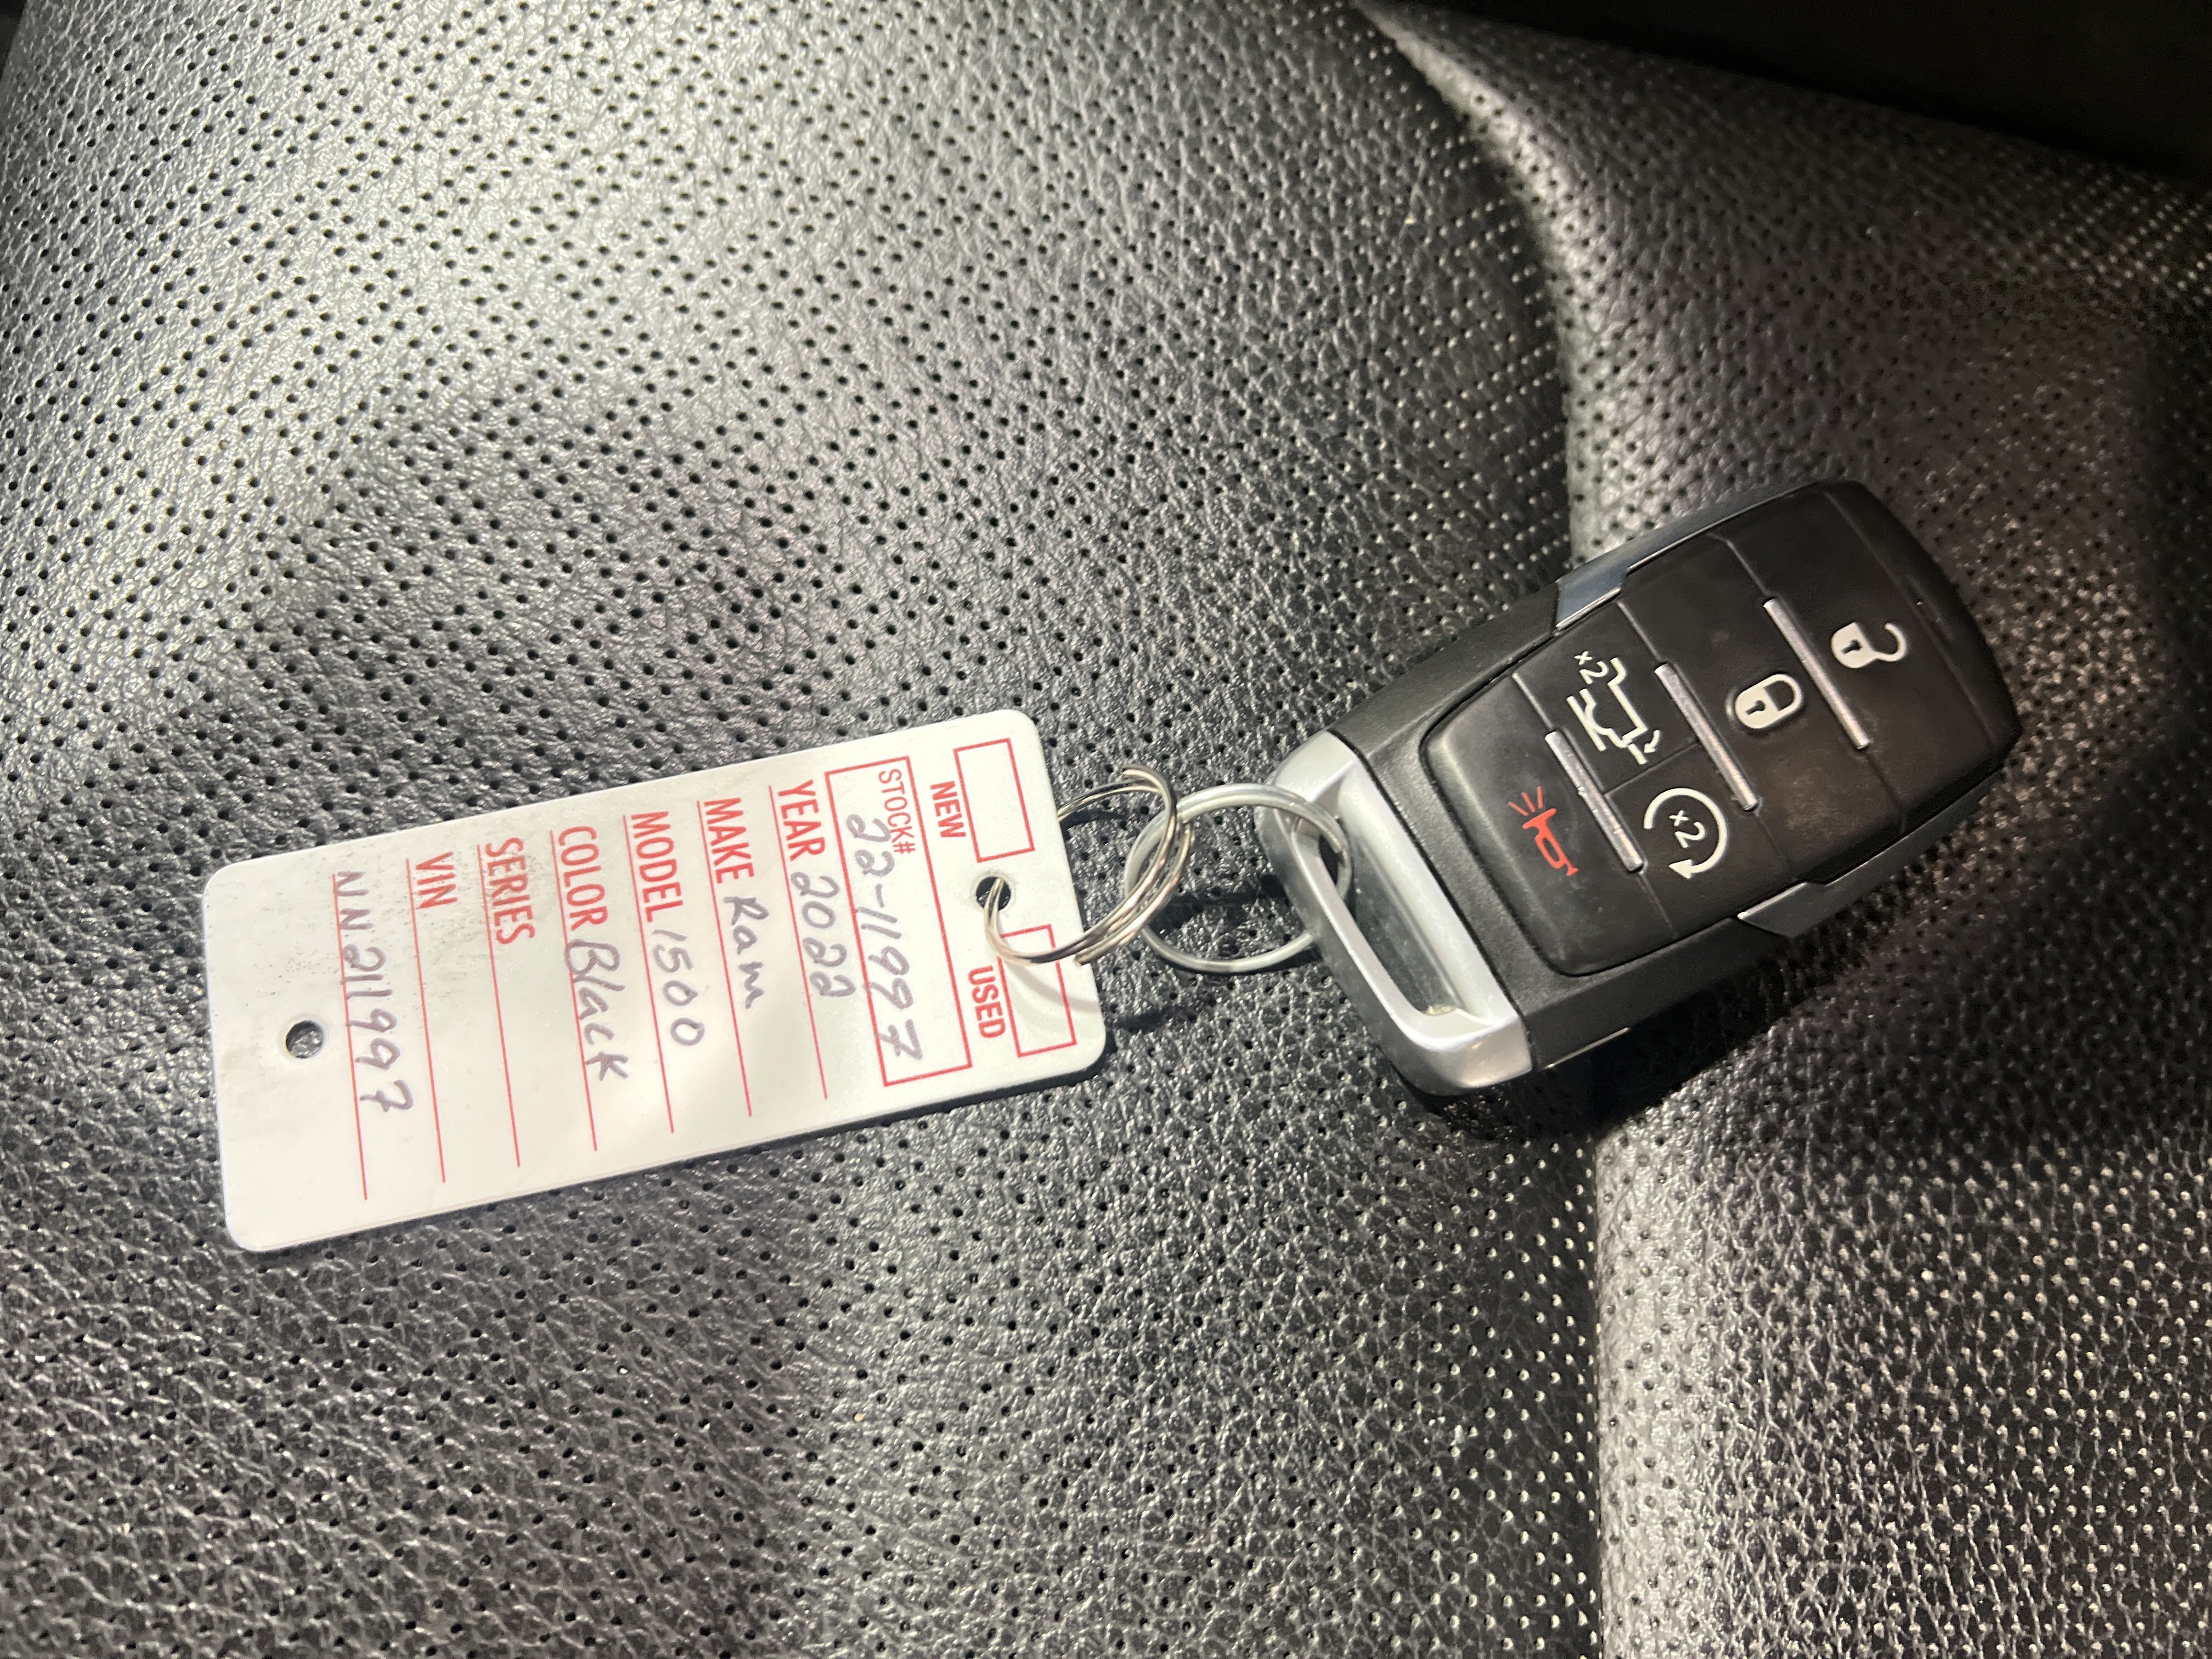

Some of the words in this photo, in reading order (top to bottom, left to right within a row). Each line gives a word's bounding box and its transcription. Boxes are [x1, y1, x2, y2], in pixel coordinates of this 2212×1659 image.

[705, 797, 754, 883] MAKE
[777, 780, 825, 860] YEAR
[879, 769, 916, 854] STOCK#
[930, 781, 966, 838] NEW
[416, 851, 458, 909] VIN
[486, 838, 535, 945] SERIES
[558, 826, 608, 930] COLOR
[630, 811, 683, 922] MODEL
[725, 896, 769, 1008] Ram
[792, 872, 855, 997] 2022
[847, 814, 922, 1060] 22-11997
[564, 939, 629, 1081] Black
[653, 929, 704, 1046] 1500
[968, 967, 1006, 1039] USED
